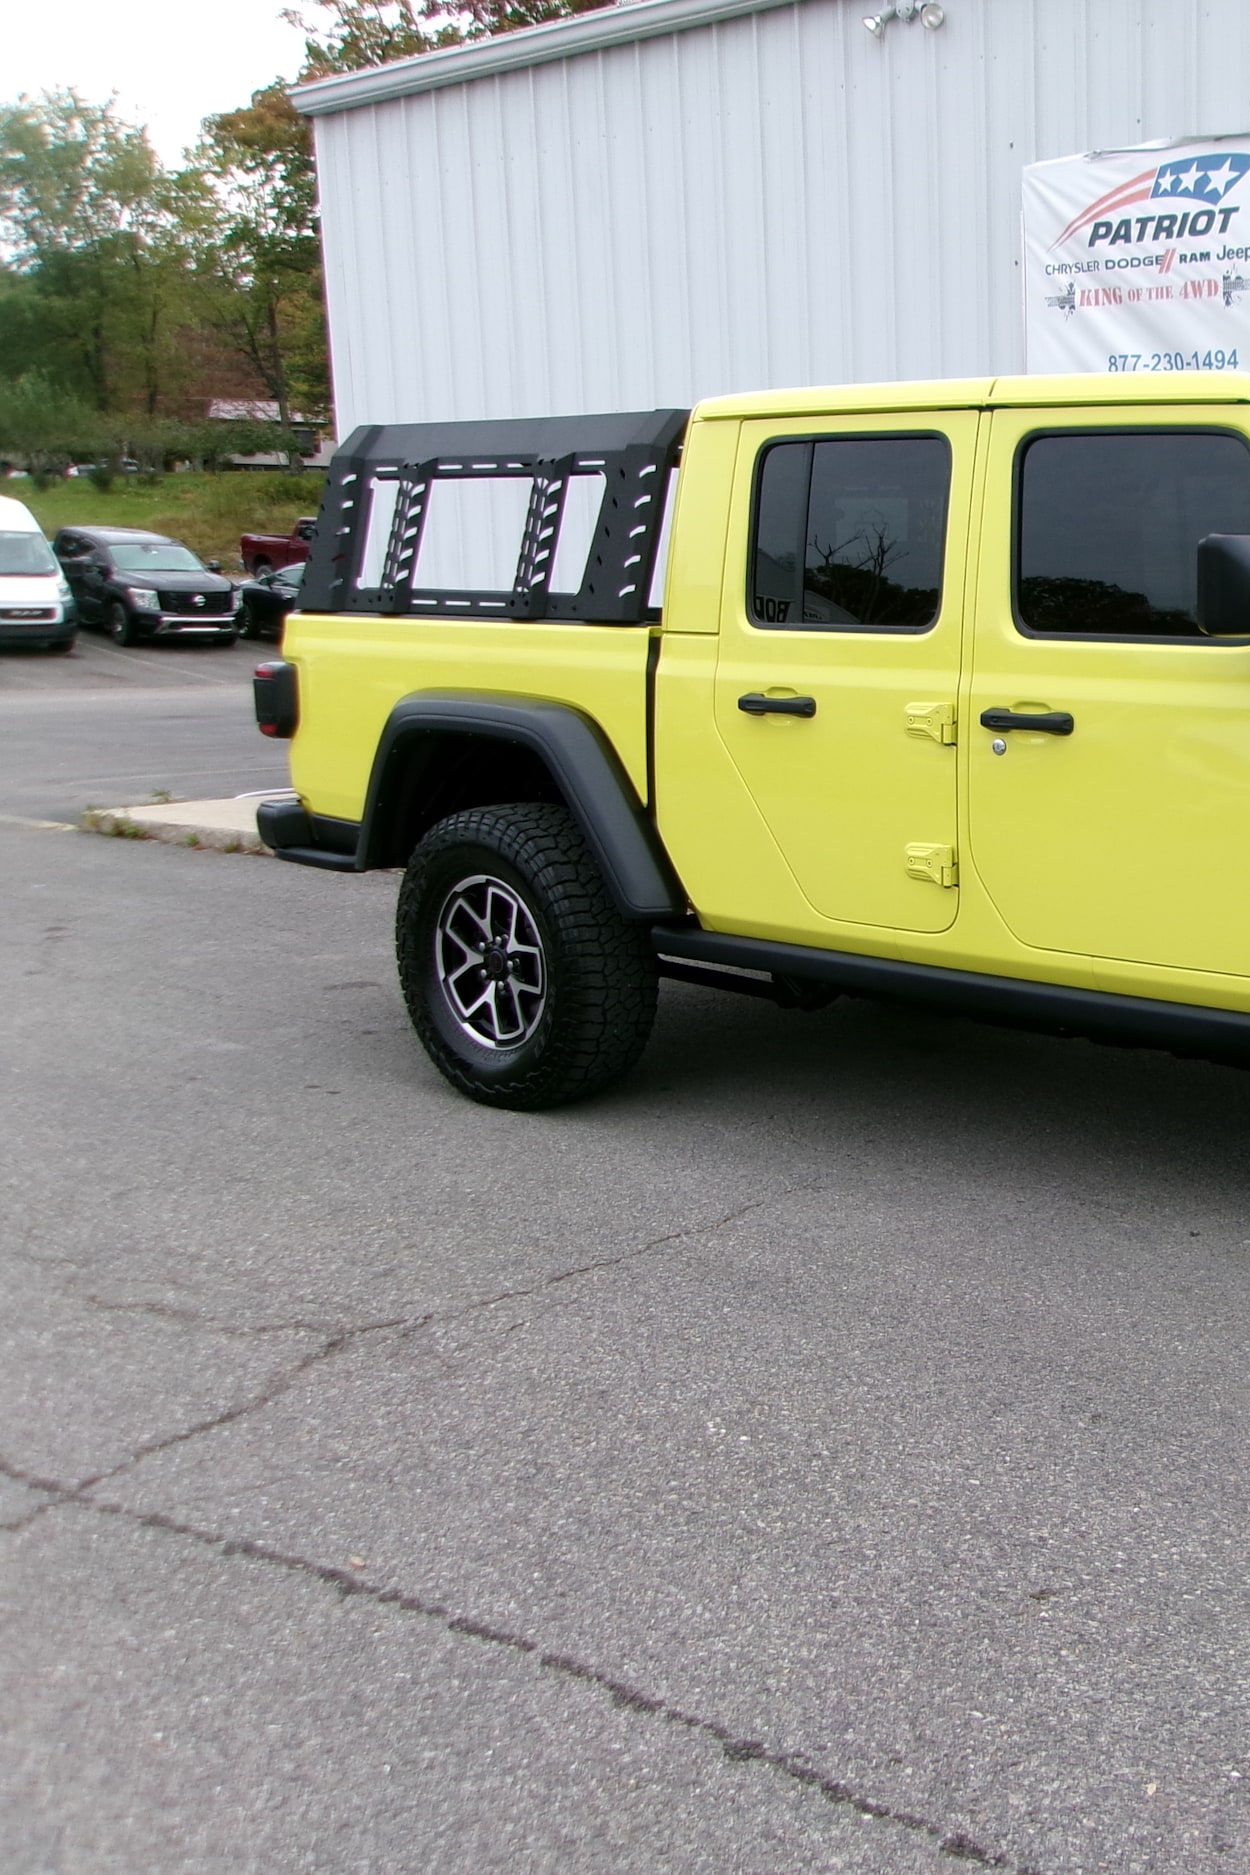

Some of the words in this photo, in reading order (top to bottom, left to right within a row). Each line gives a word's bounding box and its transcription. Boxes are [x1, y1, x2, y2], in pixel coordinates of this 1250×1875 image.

[1088, 206, 1240, 248] PATRIOT
[1045, 260, 1100, 275] CHRYSLER
[1105, 255, 1164, 270] DODGE
[1179, 251, 1211, 264] RAM
[1079, 286, 1123, 307] KING
[1128, 288, 1143, 301] OF
[1146, 285, 1174, 300] THE
[1179, 278, 1219, 299] 4WD
[1108, 349, 1239, 372] 877-230-1494
